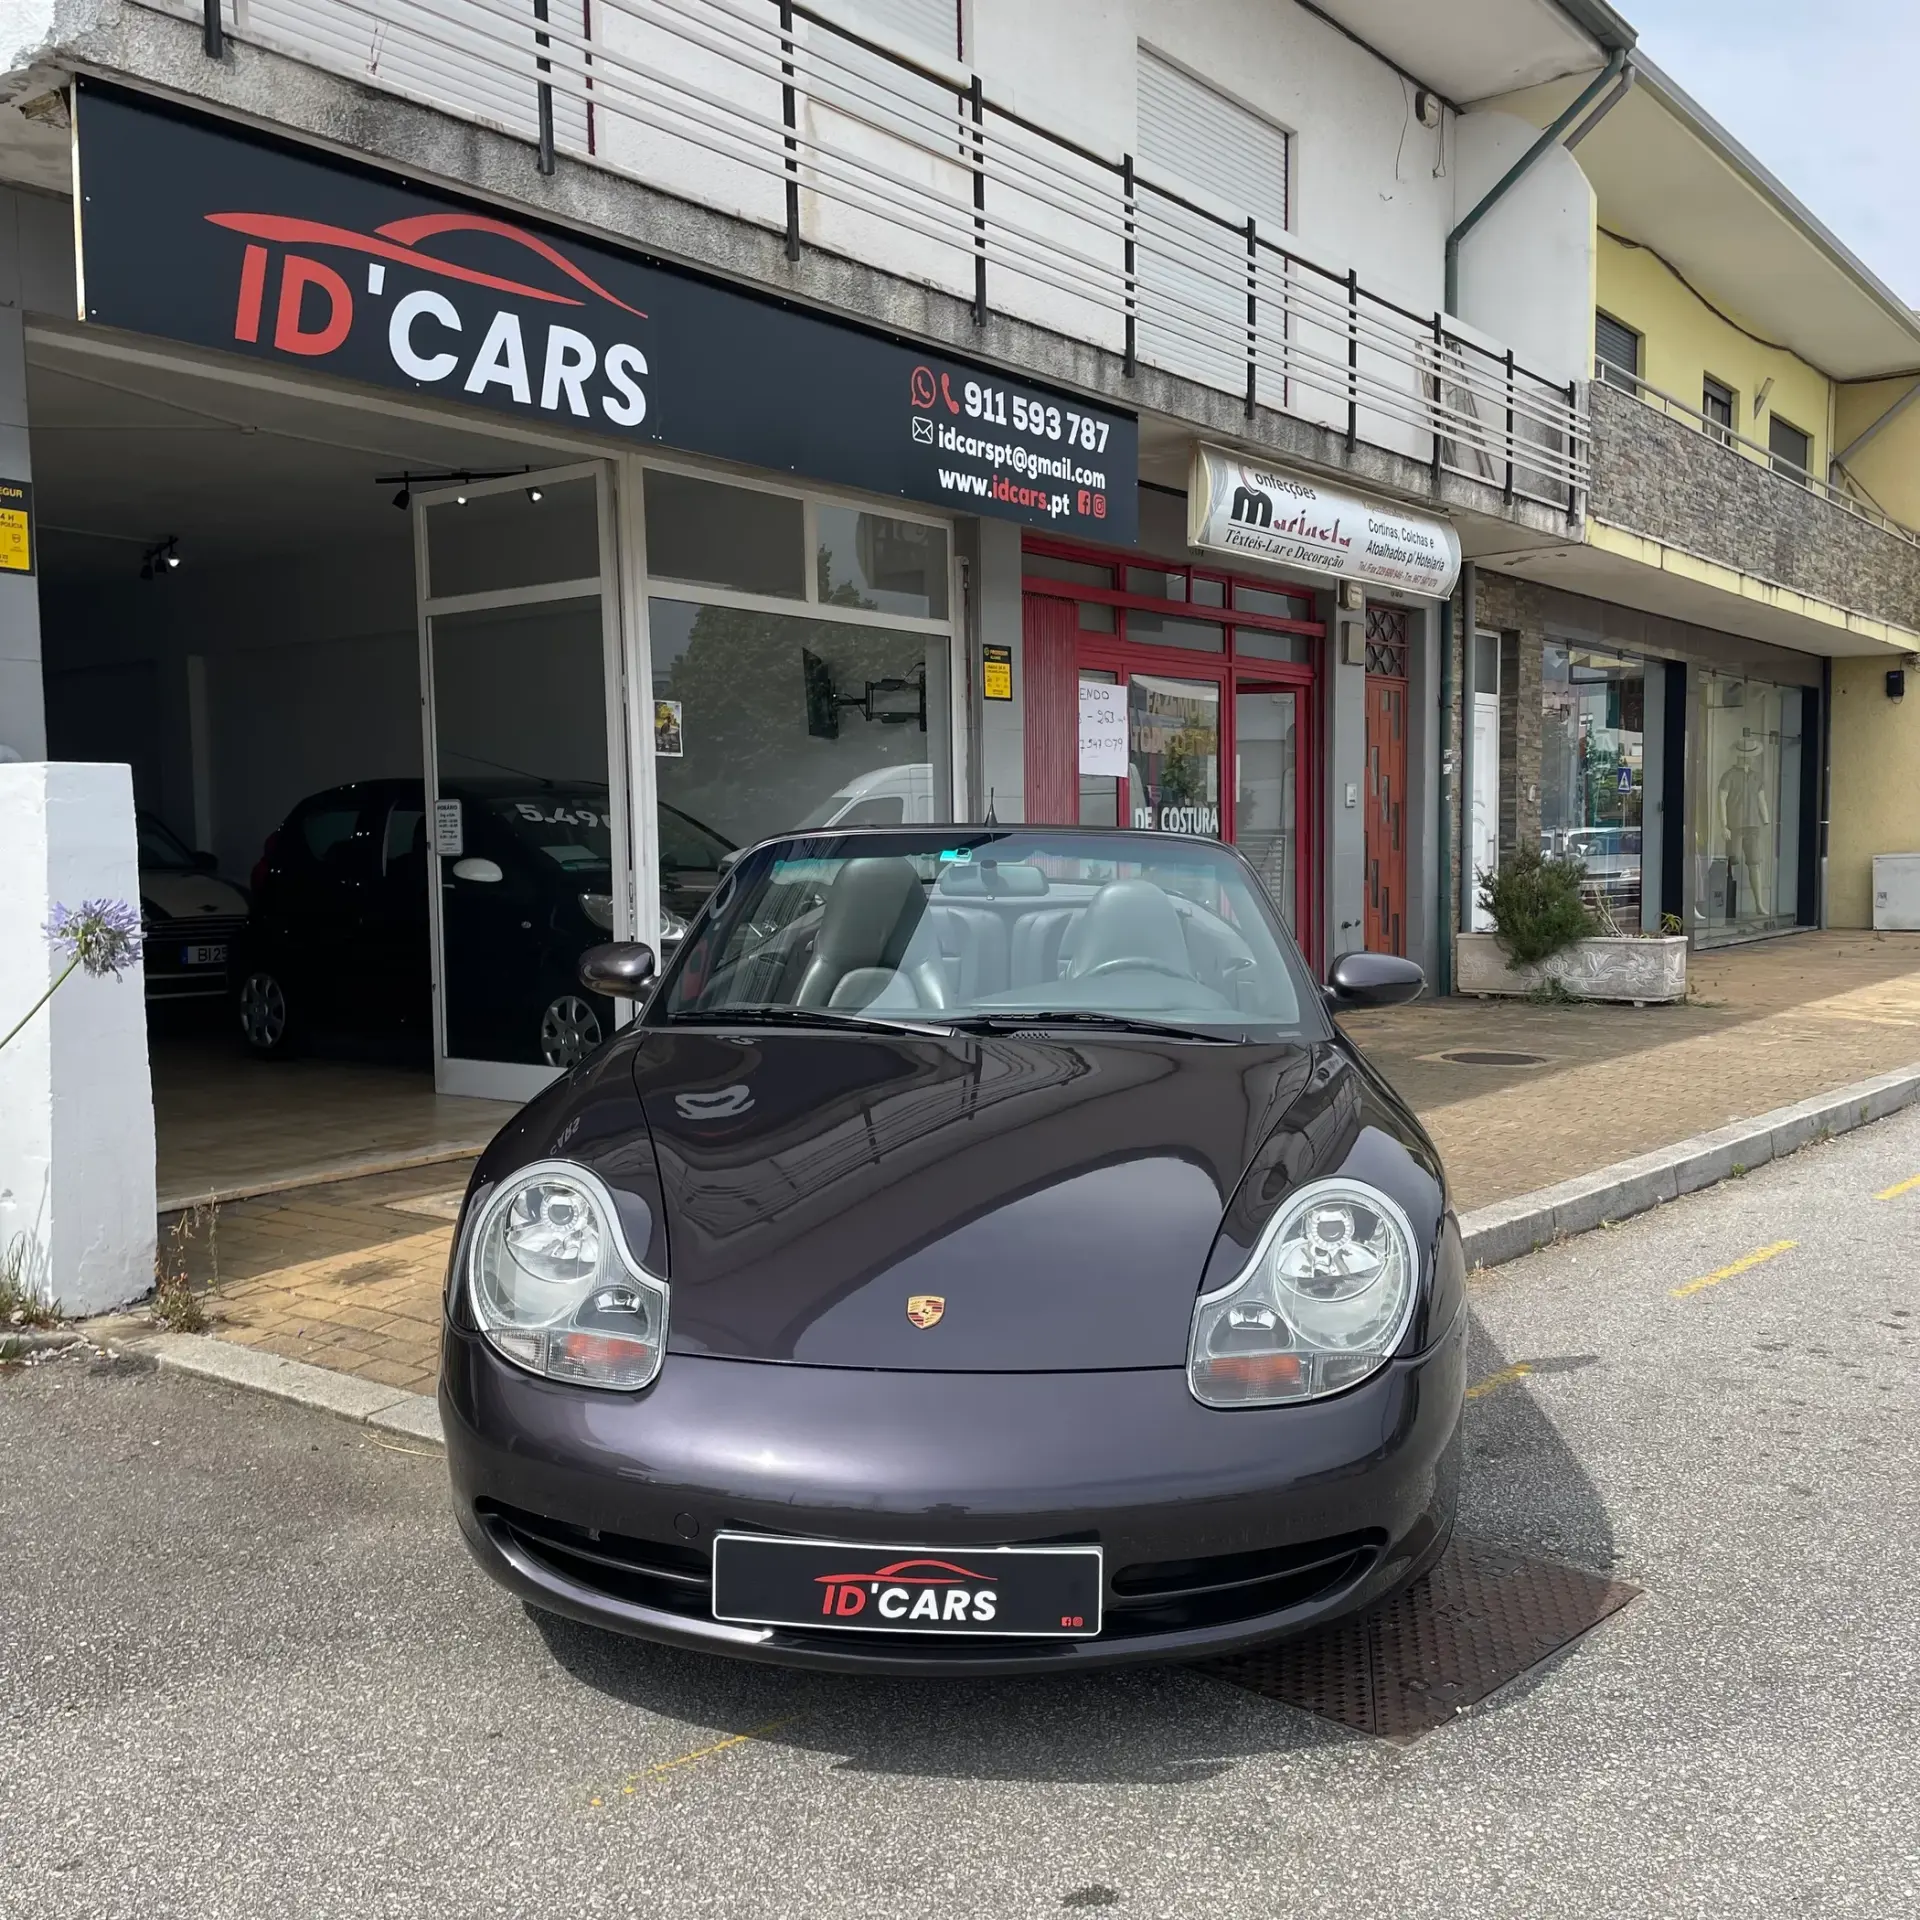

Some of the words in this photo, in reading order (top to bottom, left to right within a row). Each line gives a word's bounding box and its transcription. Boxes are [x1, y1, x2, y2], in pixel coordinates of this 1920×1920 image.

[964, 381, 1007, 426] 911
[1012, 395, 1061, 440] 593
[1066, 411, 1110, 453] 787
[938, 423, 1106, 490] idcarspt@gmail.com
[938, 468, 1070, 518] www.idcars.pt
[1225, 529, 1286, 556] Têxteis-Lar
[1287, 547, 1294, 557] e
[1294, 546, 1344, 569] Decoração
[1365, 540, 1406, 562] Atoalhados
[1414, 551, 1445, 572] Hotelaria
[1401, 527, 1428, 548] Colchas
[1429, 538, 1434, 549] e
[1079, 687, 1110, 701] ENDO
[1134, 806, 1154, 829] DE
[1161, 806, 1219, 834] COSTURA
[822, 1582, 998, 1621] ID'CARS
